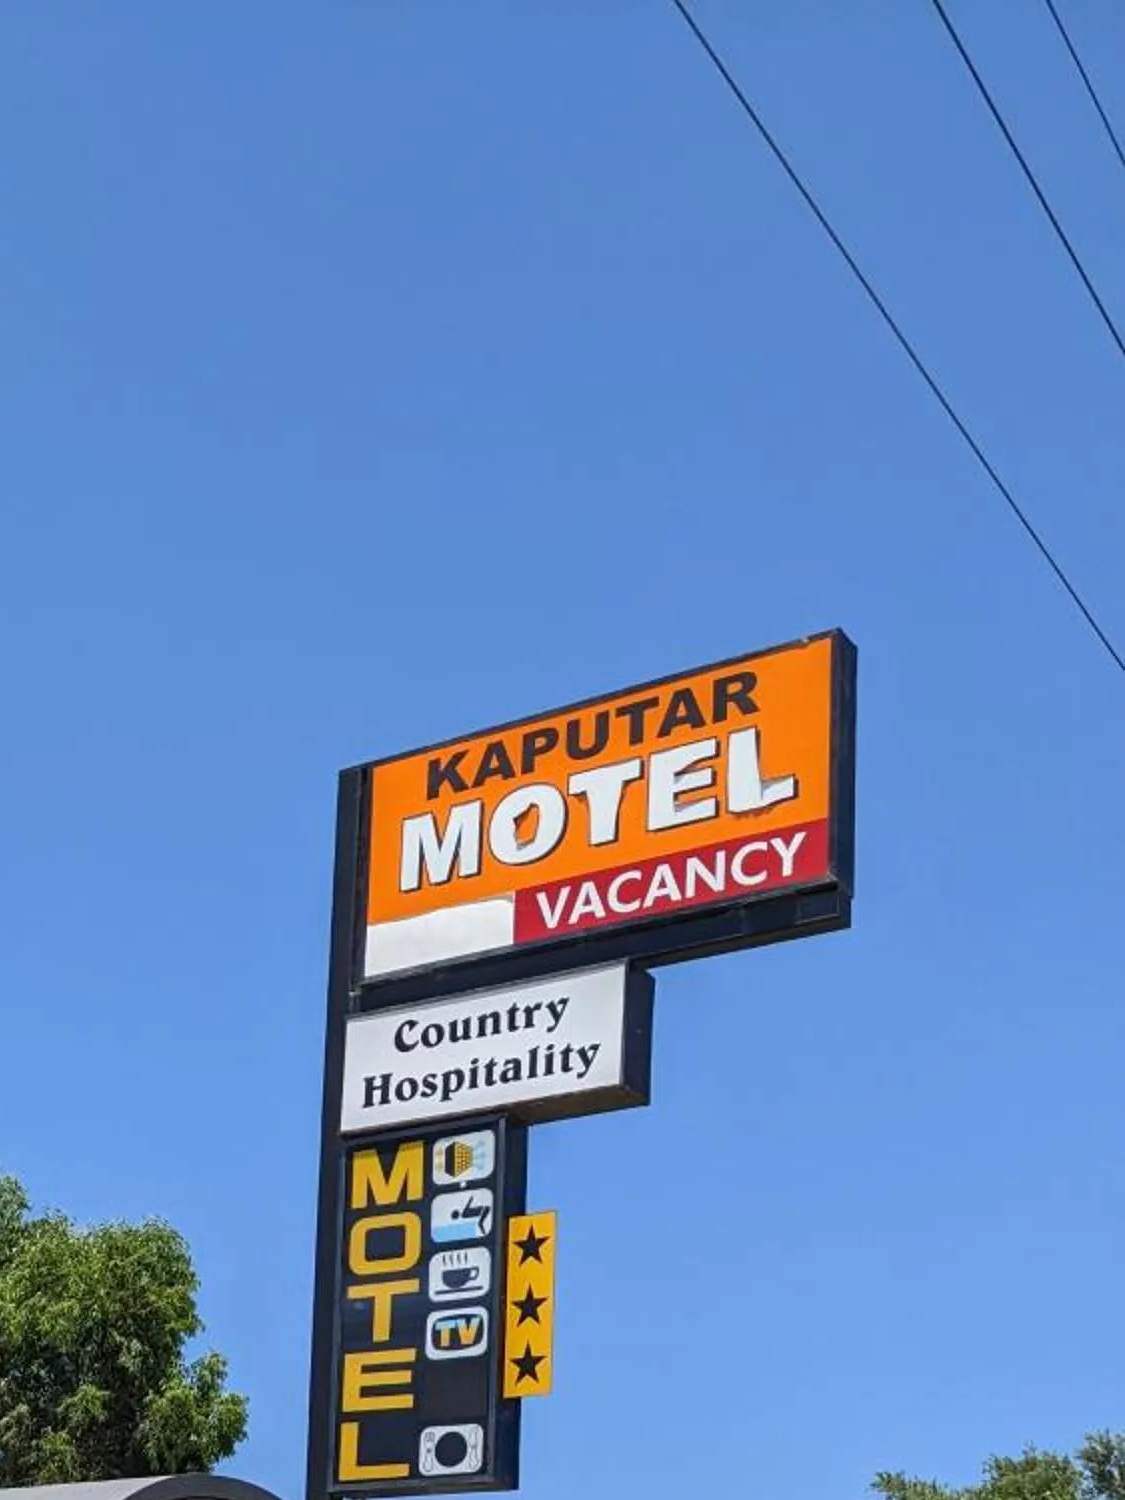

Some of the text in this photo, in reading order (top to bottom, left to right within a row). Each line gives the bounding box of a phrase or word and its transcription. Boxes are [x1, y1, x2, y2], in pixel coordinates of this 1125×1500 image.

[425, 671, 759, 800] KAPUTAR
[399, 726, 798, 892] MOTEL
[535, 831, 806, 929] VACANCY
[393, 996, 570, 1052] Country
[362, 1042, 600, 1108] Hospitality
[337, 1140, 425, 1481] MOTEL
[435, 1317, 480, 1347] TV
